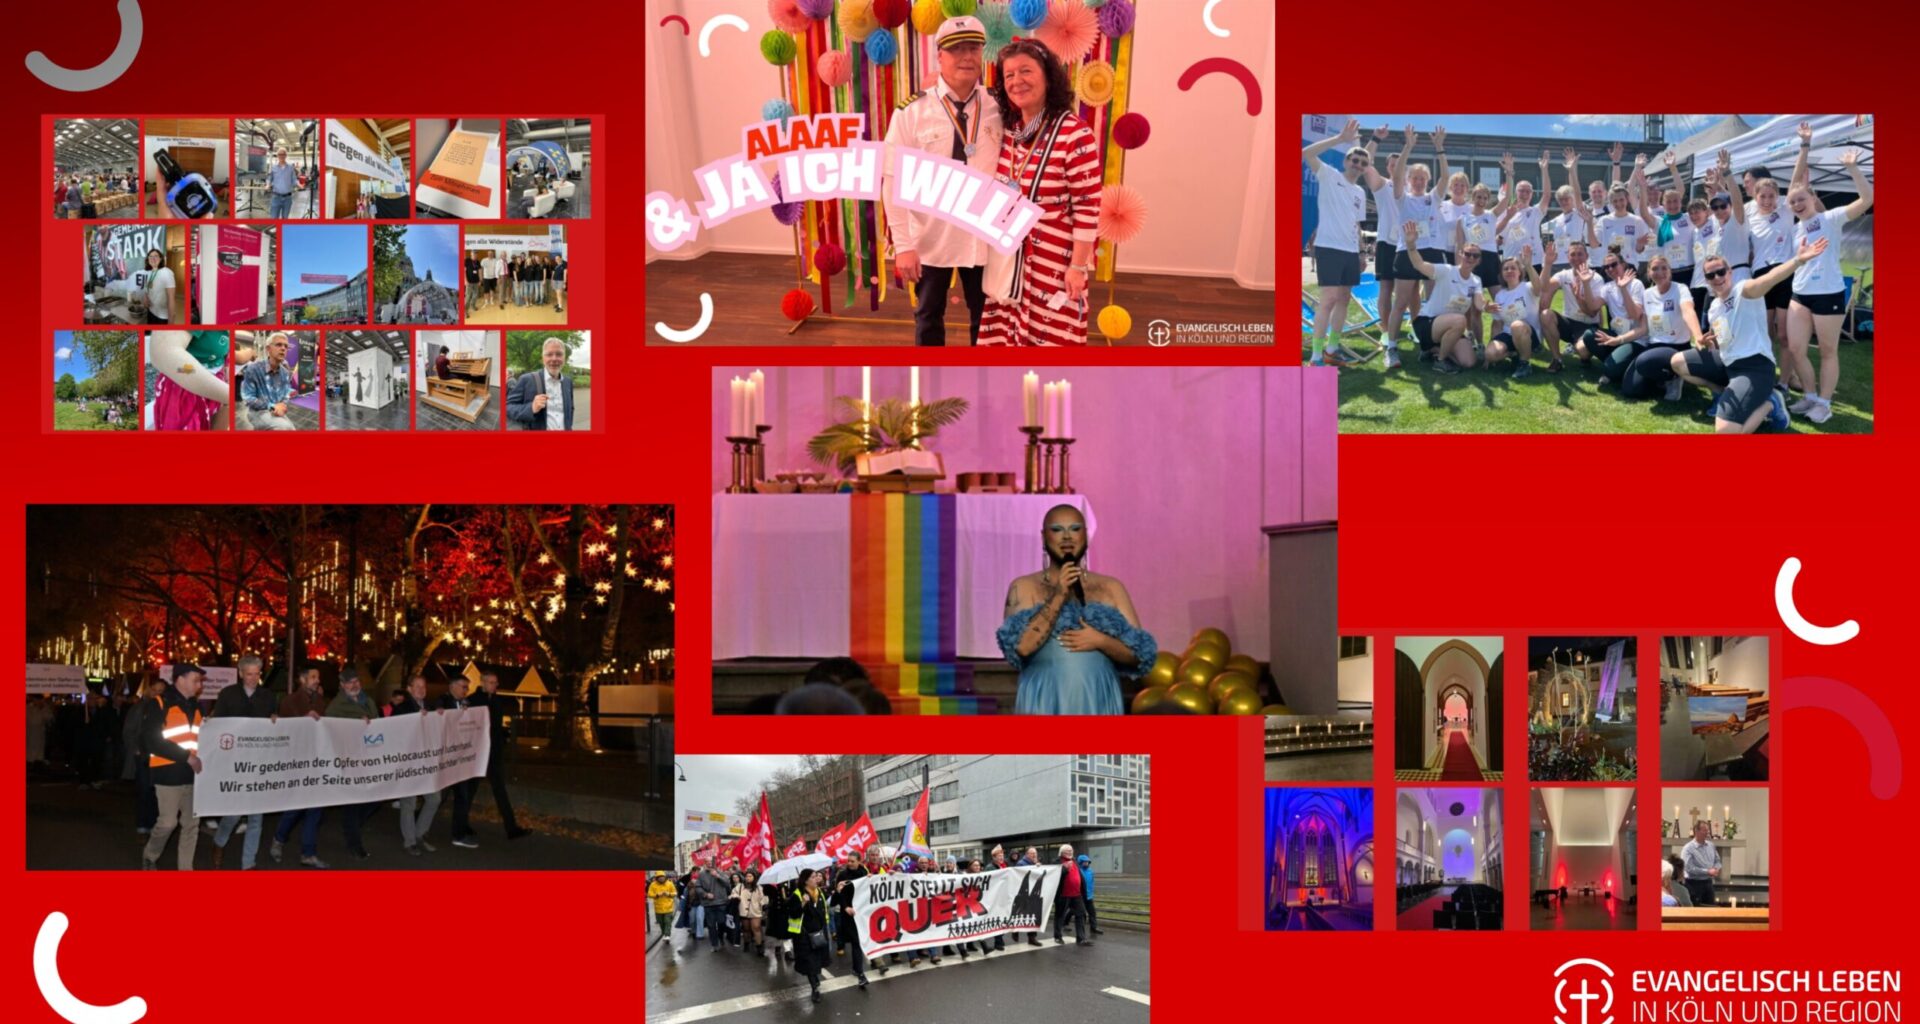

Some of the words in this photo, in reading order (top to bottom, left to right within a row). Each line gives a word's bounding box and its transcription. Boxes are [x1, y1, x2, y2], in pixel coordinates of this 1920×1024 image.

[328, 132, 363, 161] Gegen
[107, 226, 162, 260] STARK
[234, 761, 257, 773] Wir
[259, 759, 310, 775] gedenken
[312, 757, 331, 768] der
[333, 756, 359, 769] Opfer
[362, 756, 381, 767] von
[383, 748, 432, 764] Holocaust
[220, 780, 243, 793] Wir
[246, 779, 286, 793] stehen
[288, 778, 300, 788] an
[302, 775, 320, 787] der
[322, 773, 352, 786] Seite
[354, 771, 394, 785] unserer
[394, 763, 438, 781] jüdischen
[836, 825, 872, 860] SPD
[869, 876, 905, 904] KÖLN
[910, 878, 956, 900] STELLT
[961, 874, 992, 893] SICH
[869, 888, 988, 945] QUER
